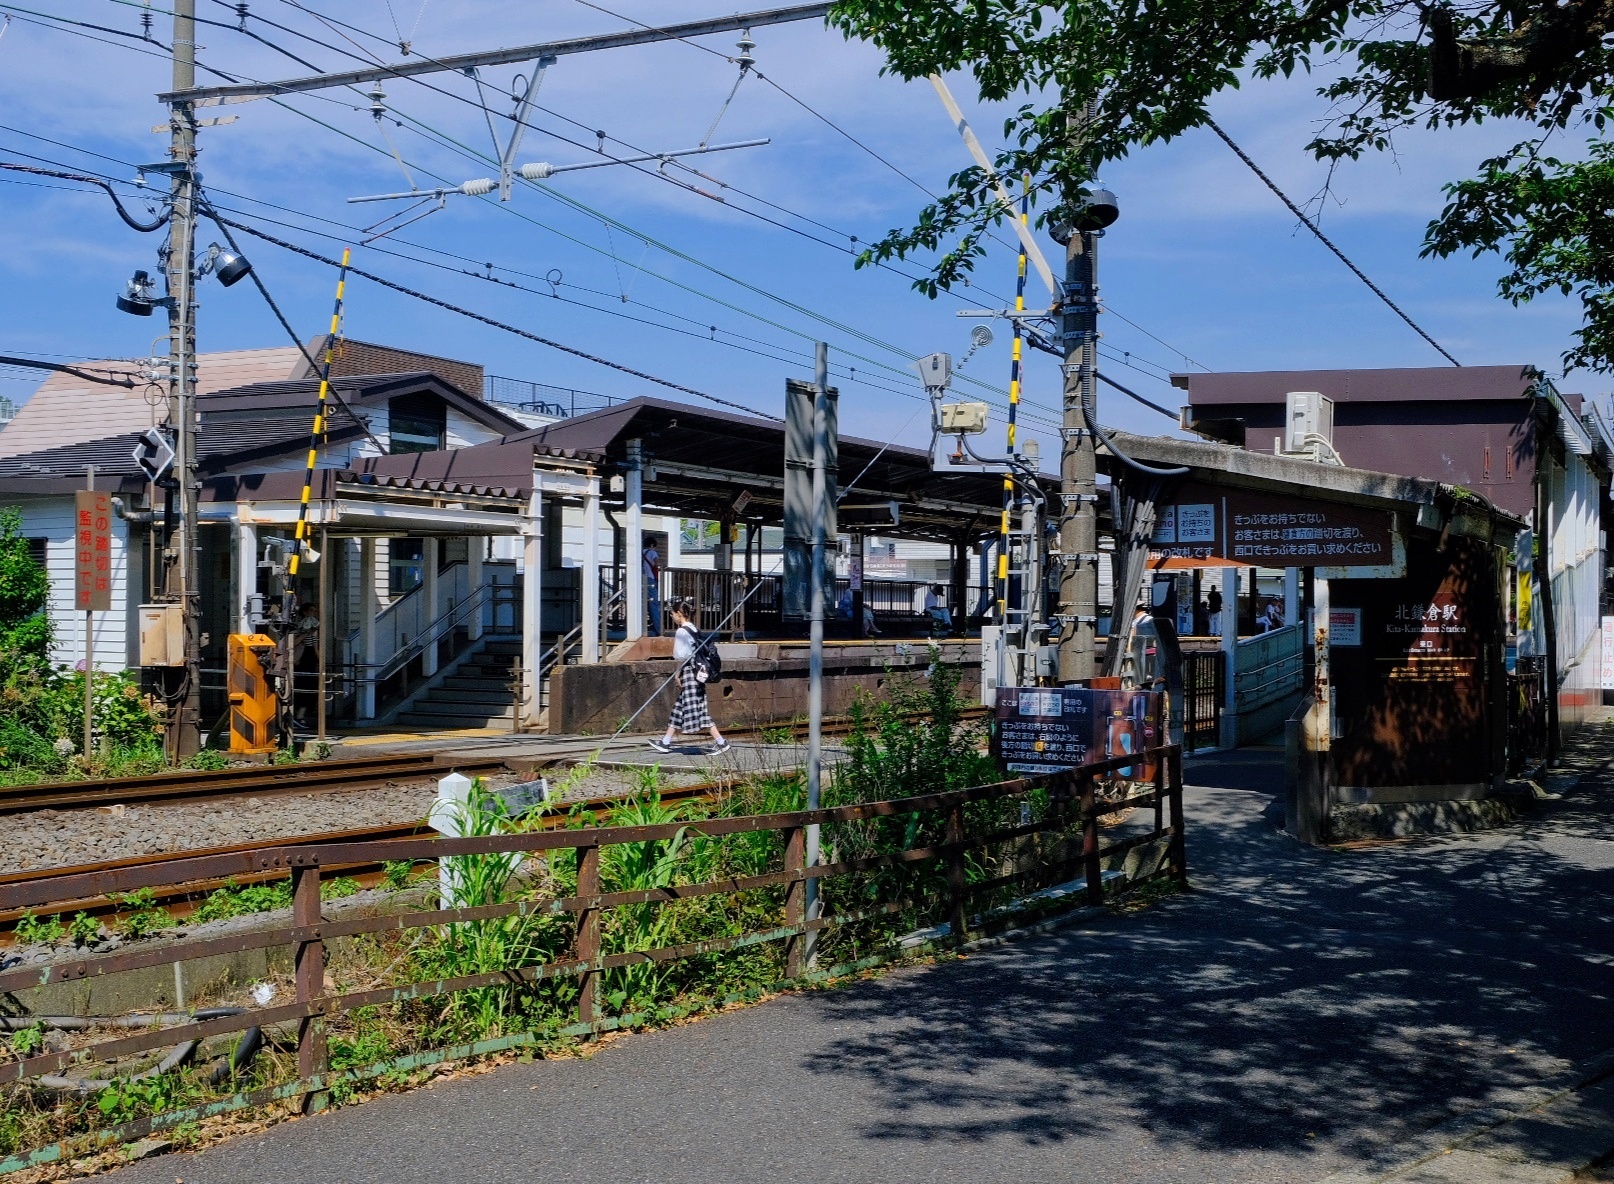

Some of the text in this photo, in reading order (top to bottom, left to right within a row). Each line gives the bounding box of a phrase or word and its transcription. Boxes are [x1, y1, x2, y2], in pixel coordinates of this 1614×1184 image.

[1181, 519, 1211, 527] お持ちの
[1234, 513, 1326, 525] きっぷをお持ちでない
[1182, 528, 1211, 537] お客さま
[95, 496, 108, 591] この踏切は
[1234, 543, 1382, 557] 西口できっぷをお買い求めください
[79, 510, 92, 606] 監視中です
[1146, 546, 1214, 560] 用の改札です
[1394, 603, 1459, 621] 北鎌倉駅
[1386, 624, 1467, 633] Kita-Kamakura Station
[1001, 722, 1070, 732] きっぷをお持ちでない
